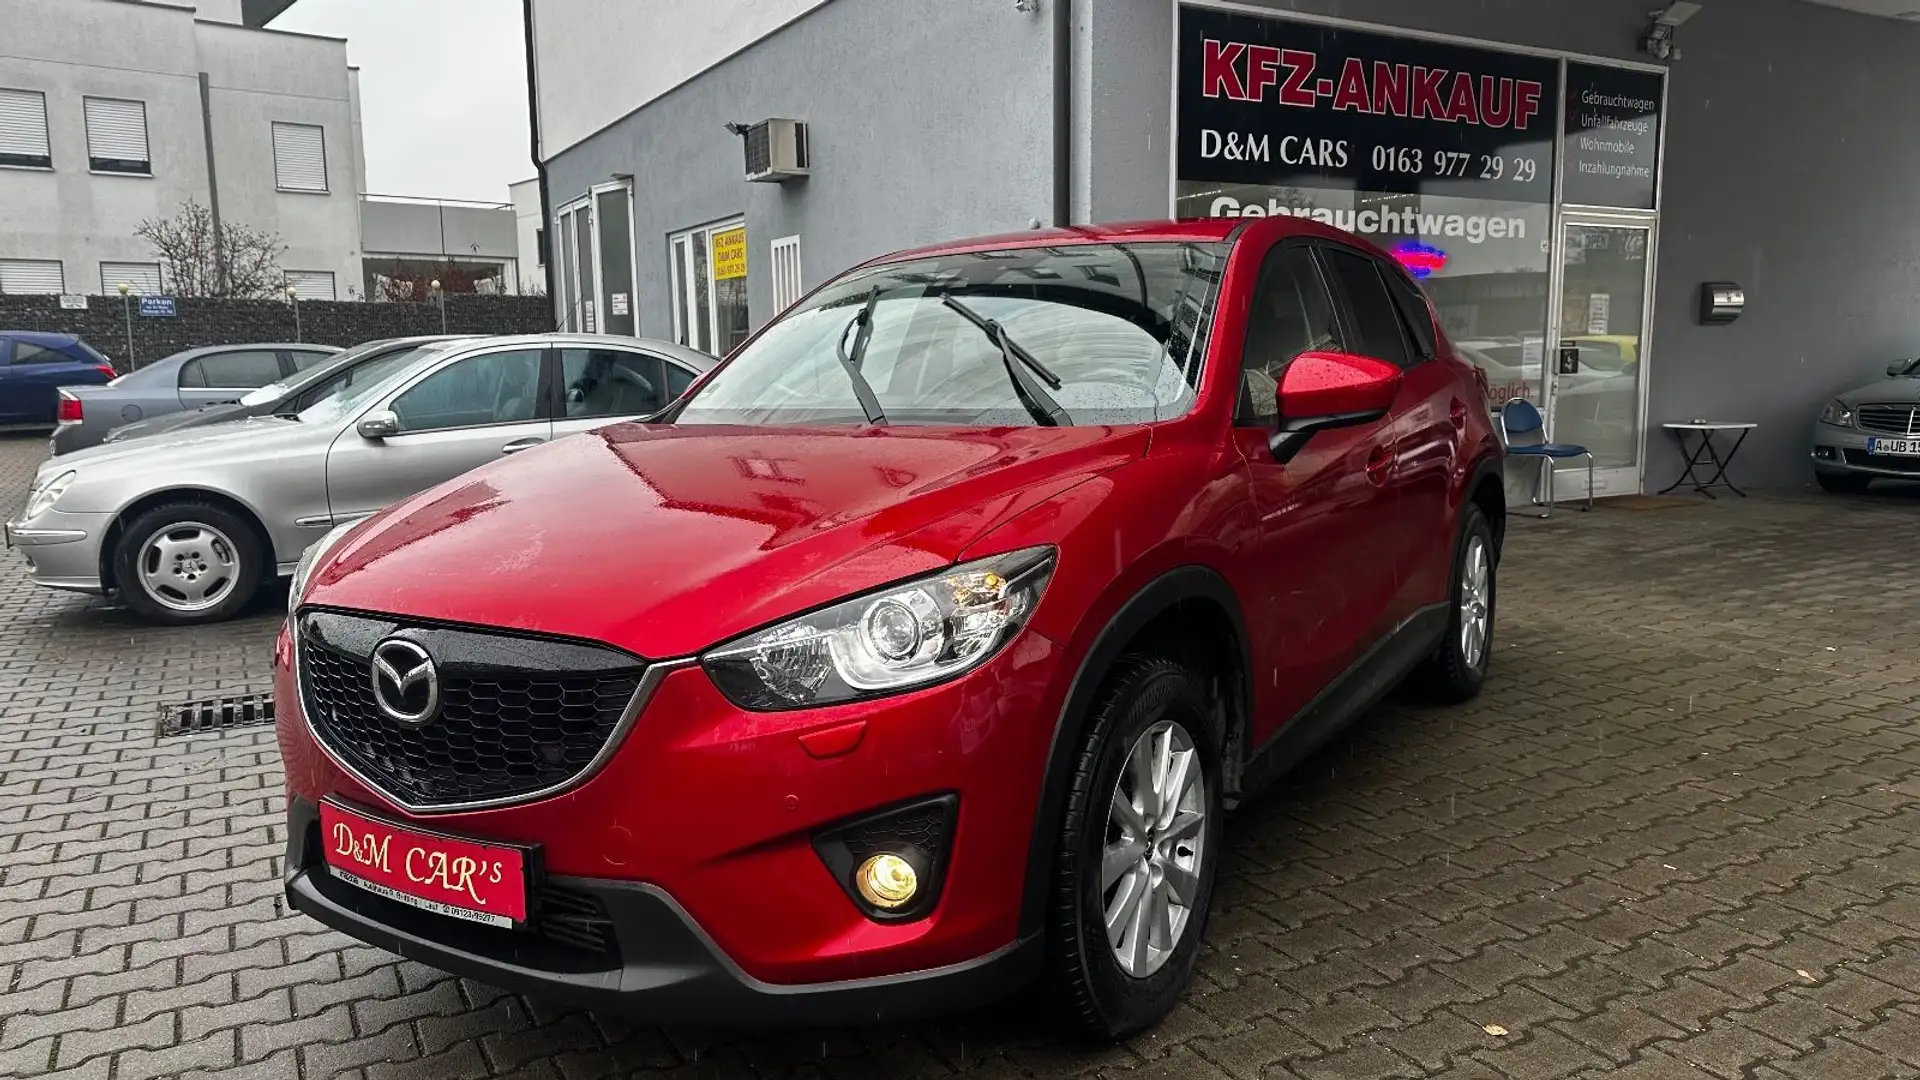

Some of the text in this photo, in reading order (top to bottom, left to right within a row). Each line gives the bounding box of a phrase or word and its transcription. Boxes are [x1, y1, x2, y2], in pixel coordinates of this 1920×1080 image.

[1203, 39, 1542, 129] KFZ-ANKAUF
[1581, 90, 1655, 113] Gebrauchtwagen
[1581, 113, 1649, 135] Unfallfahrzeuge
[1201, 129, 1536, 182] D&M CARS 0163 977 29 29
[1580, 136, 1635, 154] Wohnmobile
[1579, 160, 1650, 179] Inzahlungnahme
[1876, 440, 1882, 451] A
[1891, 440, 1907, 452] UB
[333, 822, 392, 873] D&M
